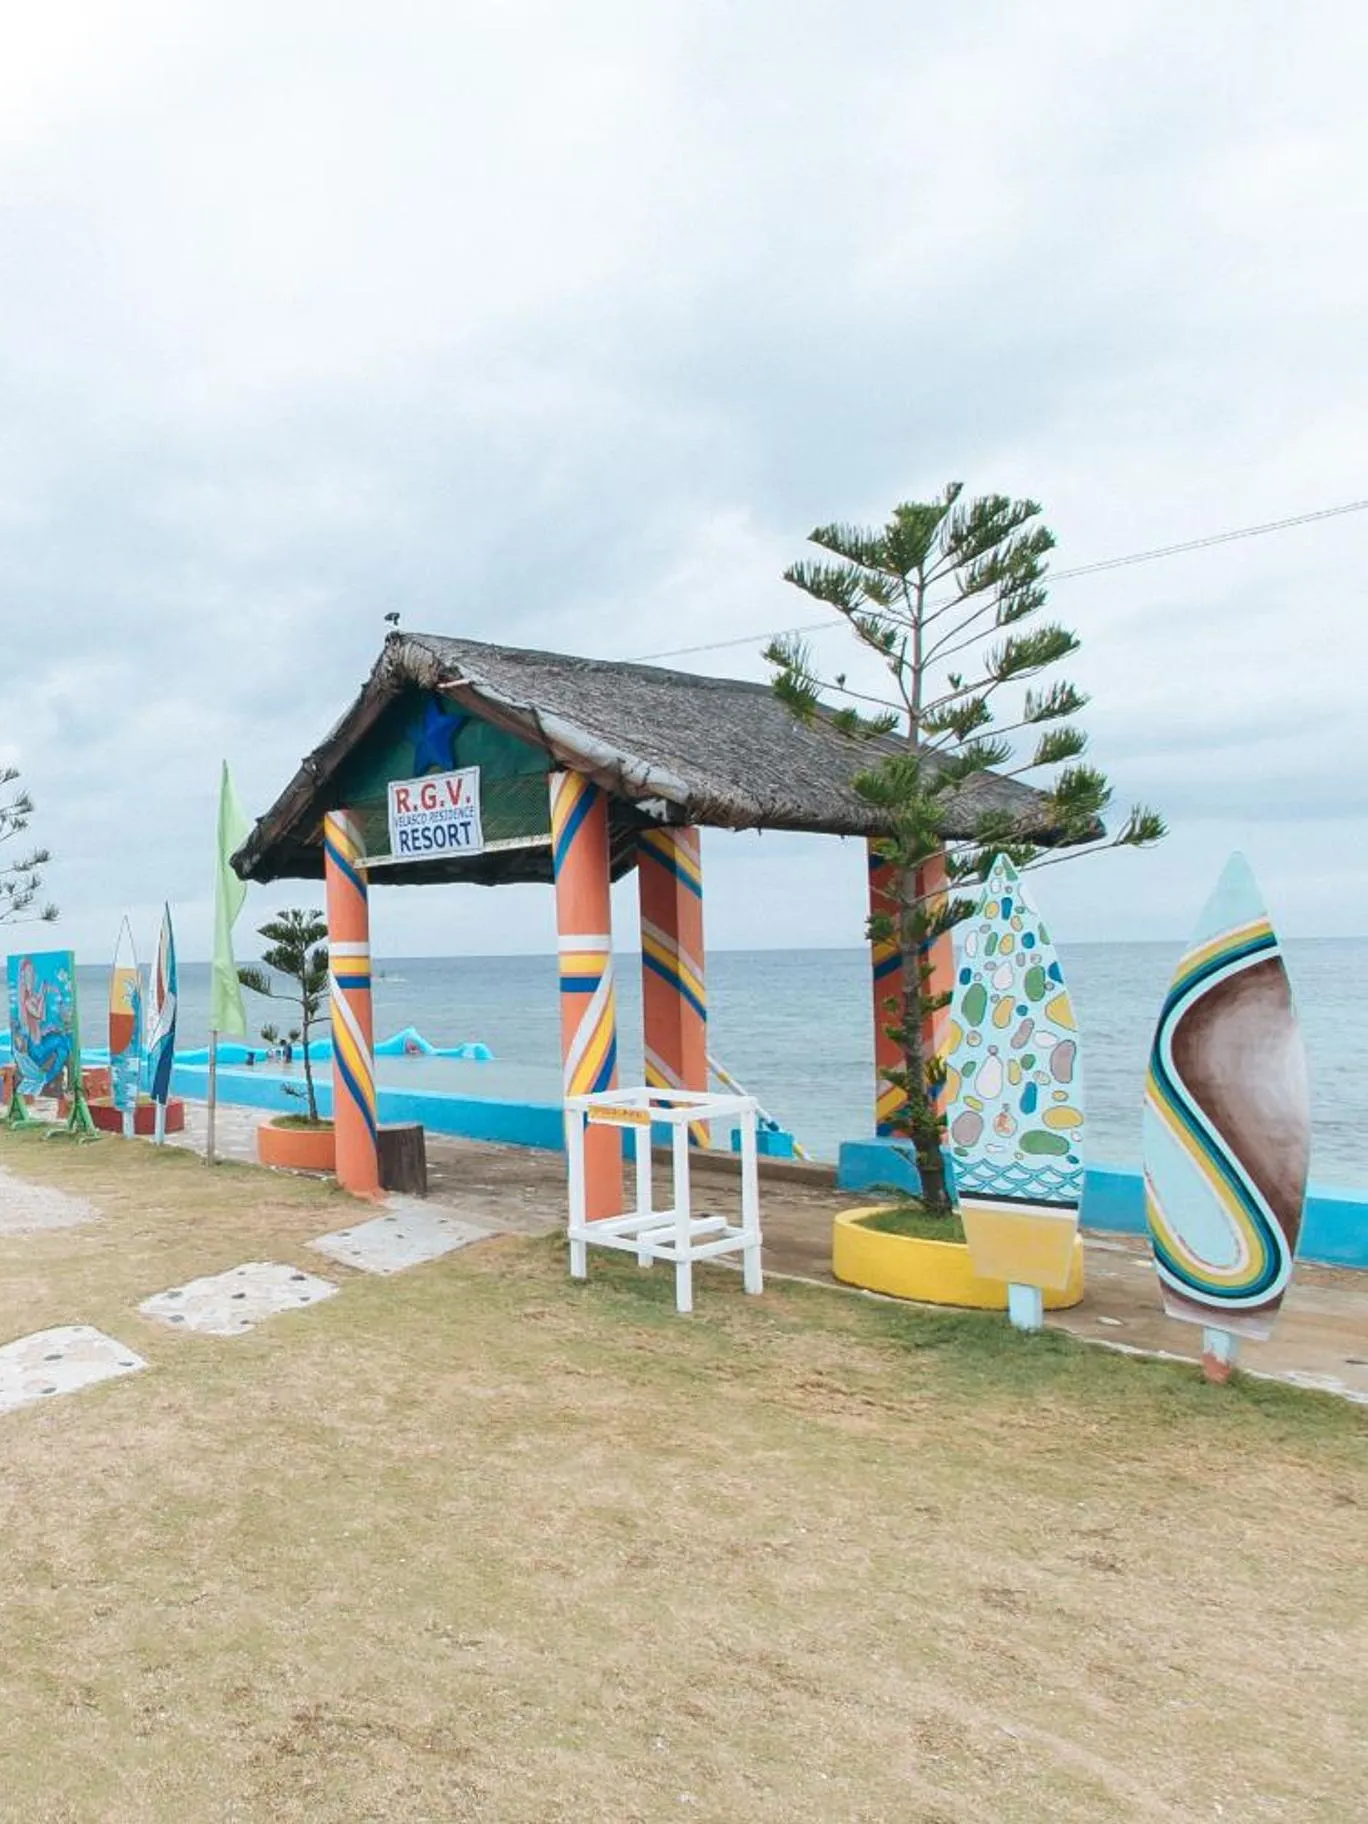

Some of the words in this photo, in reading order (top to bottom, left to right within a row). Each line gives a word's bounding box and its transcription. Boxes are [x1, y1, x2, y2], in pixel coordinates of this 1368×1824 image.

[395, 778, 471, 813] R.G.V.
[429, 806, 474, 823] RESIDENCE
[399, 821, 471, 853] RESORT
